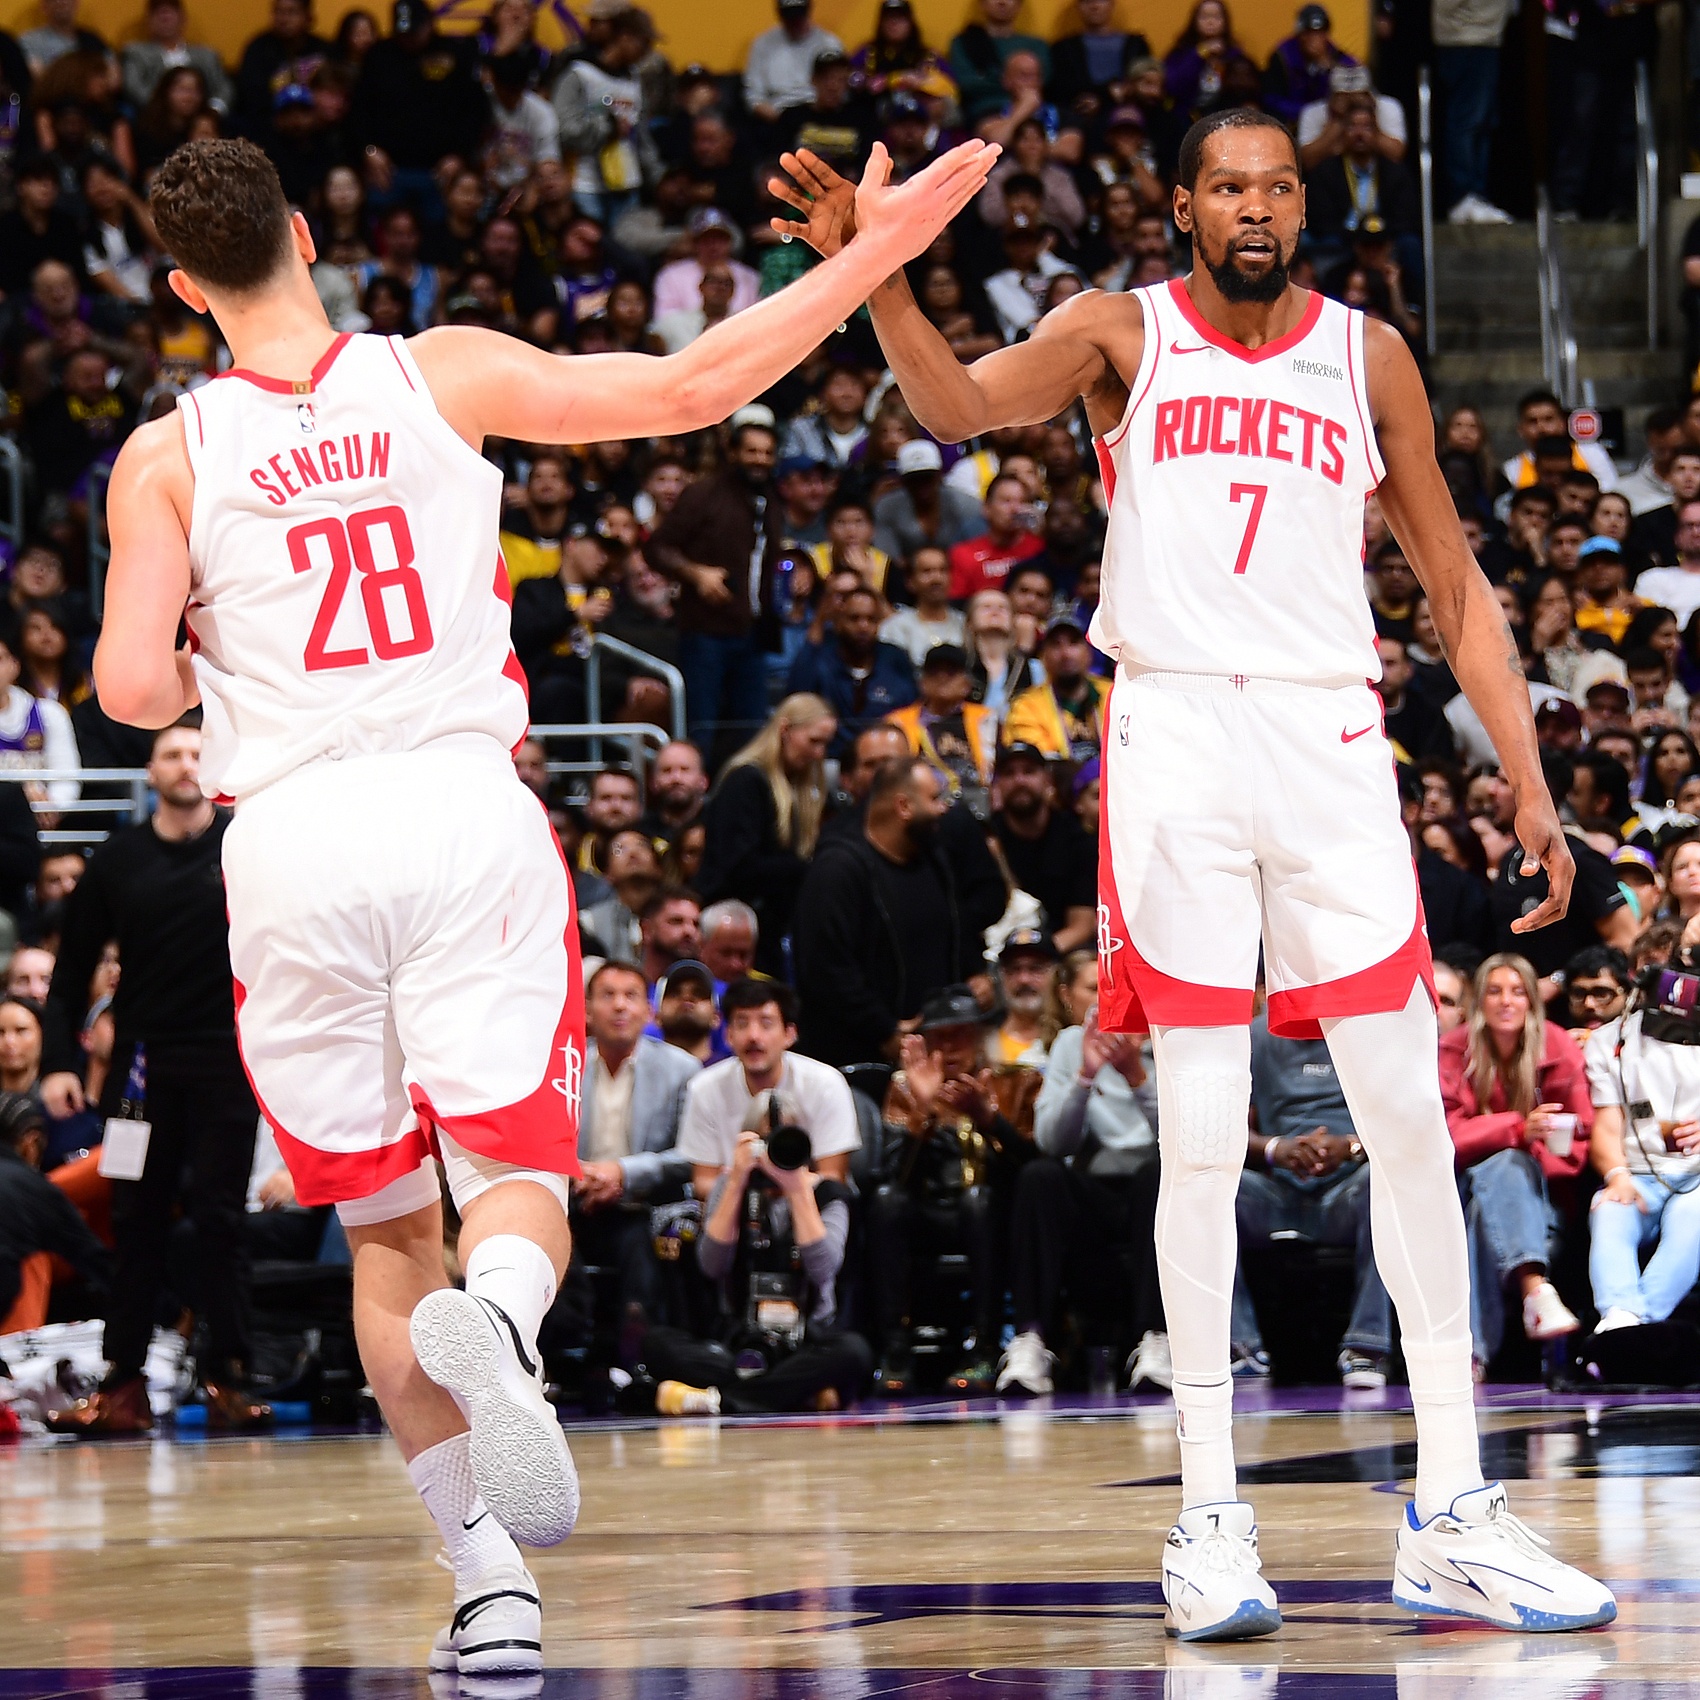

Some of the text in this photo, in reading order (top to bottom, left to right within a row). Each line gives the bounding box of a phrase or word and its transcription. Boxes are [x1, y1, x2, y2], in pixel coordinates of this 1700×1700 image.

[250, 432, 390, 506] SENGUN
[1153, 395, 1348, 486] ROCKETS
[1229, 482, 1268, 574] 7
[286, 505, 434, 672] 28
